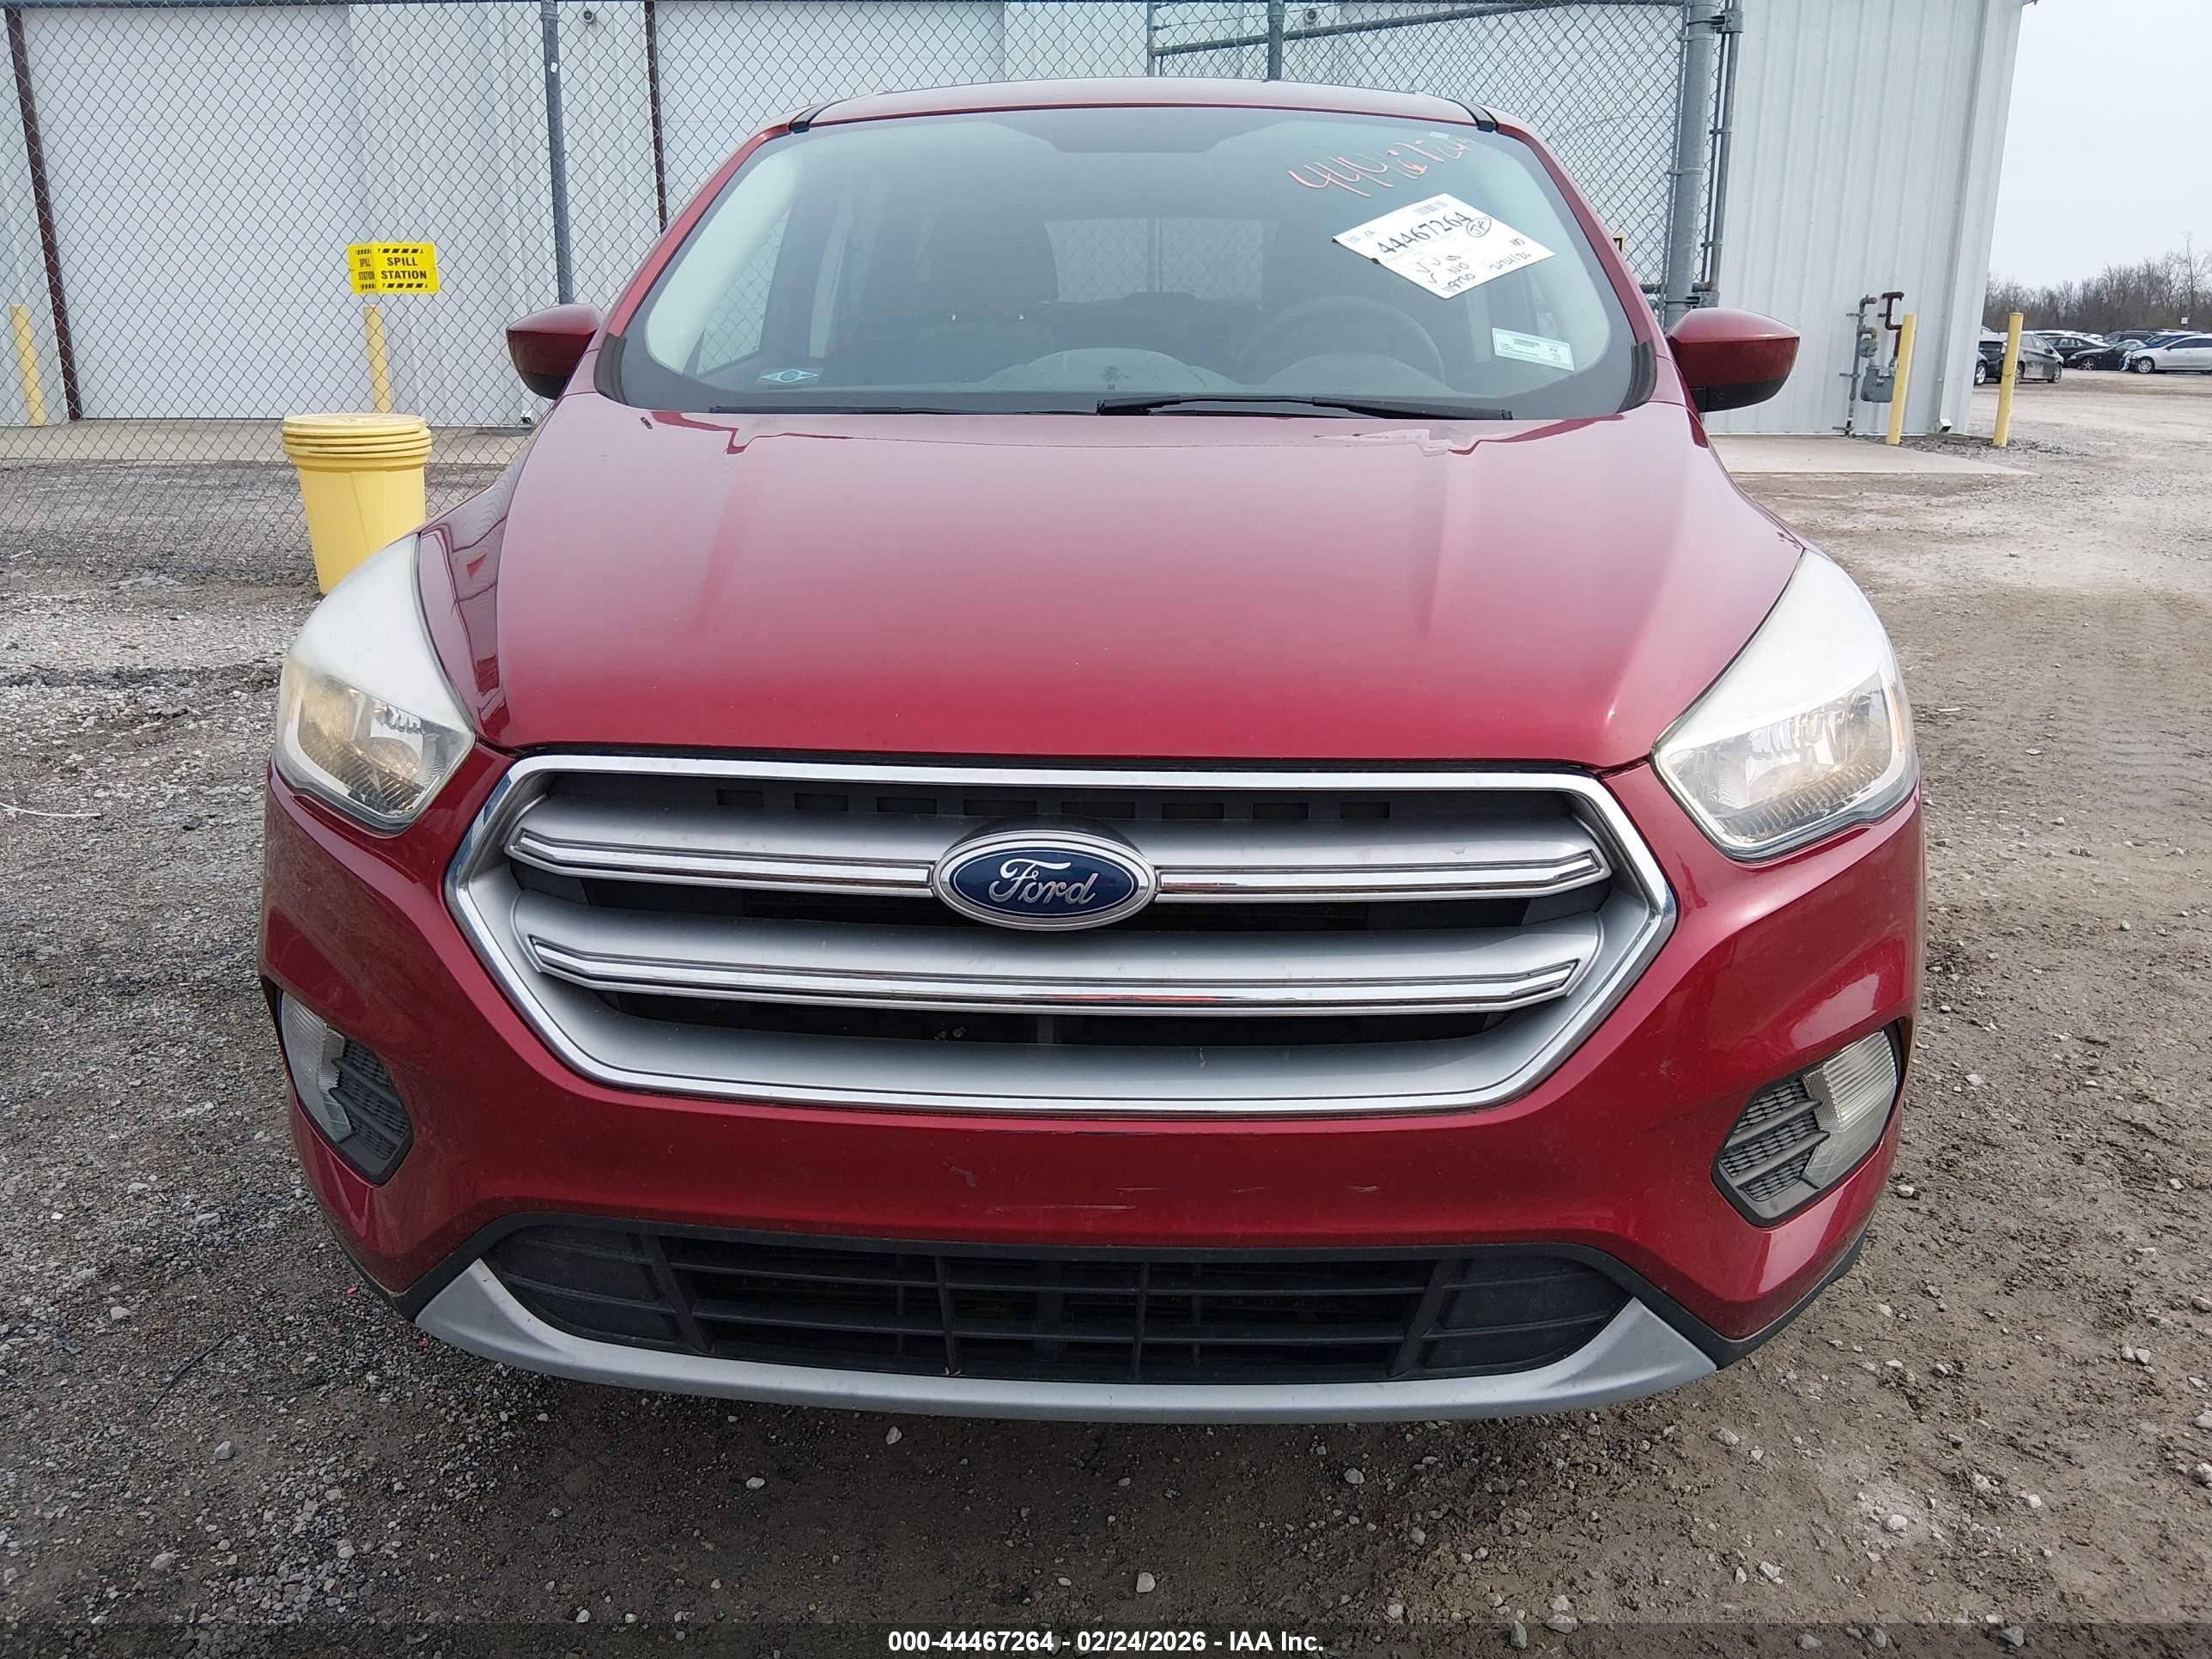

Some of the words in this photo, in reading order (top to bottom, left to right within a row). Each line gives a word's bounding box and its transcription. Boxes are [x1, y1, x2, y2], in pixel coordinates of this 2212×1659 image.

[1376, 211, 1472, 254] 44467264
[359, 258, 371, 267] SPILL
[386, 257, 418, 266] SPILL
[357, 270, 375, 281] STATION
[380, 270, 428, 280] STATION
[988, 858, 1099, 905] Ford
